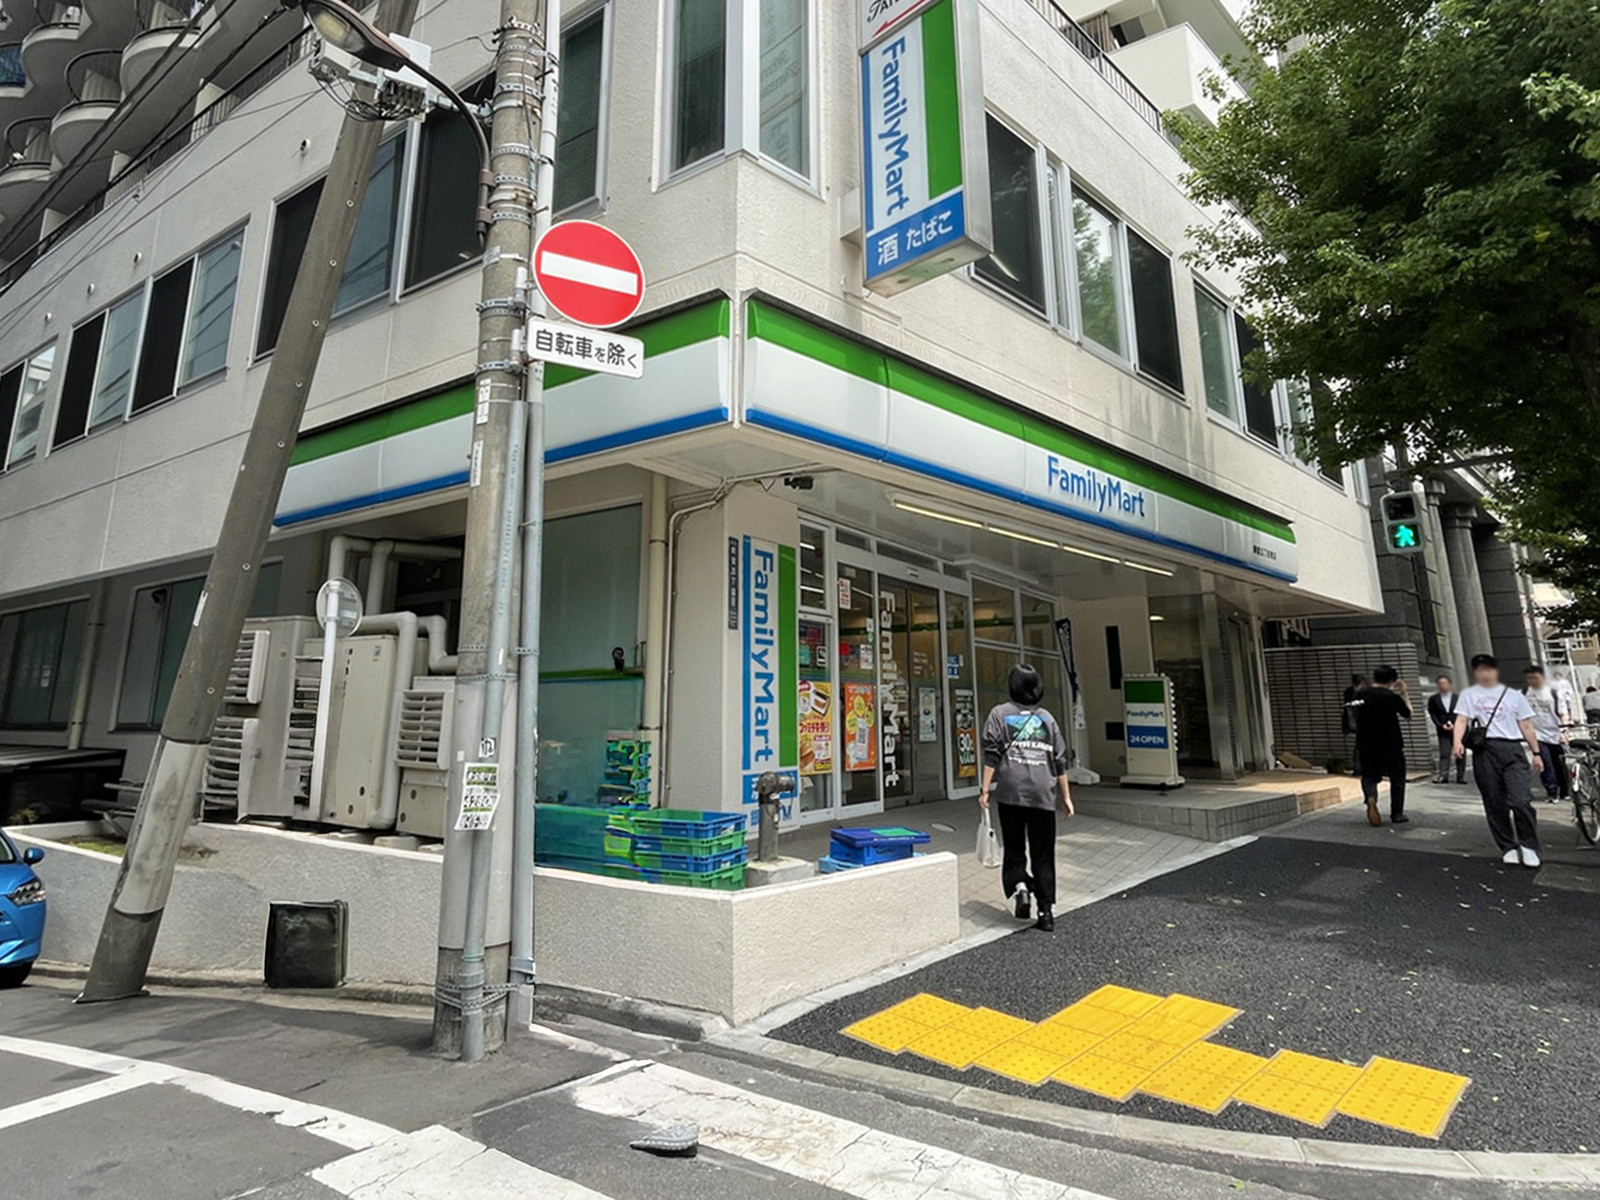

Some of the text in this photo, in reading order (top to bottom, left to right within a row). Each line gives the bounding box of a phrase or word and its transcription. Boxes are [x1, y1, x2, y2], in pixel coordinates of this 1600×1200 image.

[878, 36, 910, 217] FamilyMart
[878, 210, 953, 266] 酒 たばこ
[535, 329, 638, 369] 自転車を除く
[1047, 455, 1145, 517] FamilyMart
[751, 548, 775, 763] FamilyMart
[880, 590, 900, 787] FamilyMart
[1126, 710, 1164, 719] FamilyMart
